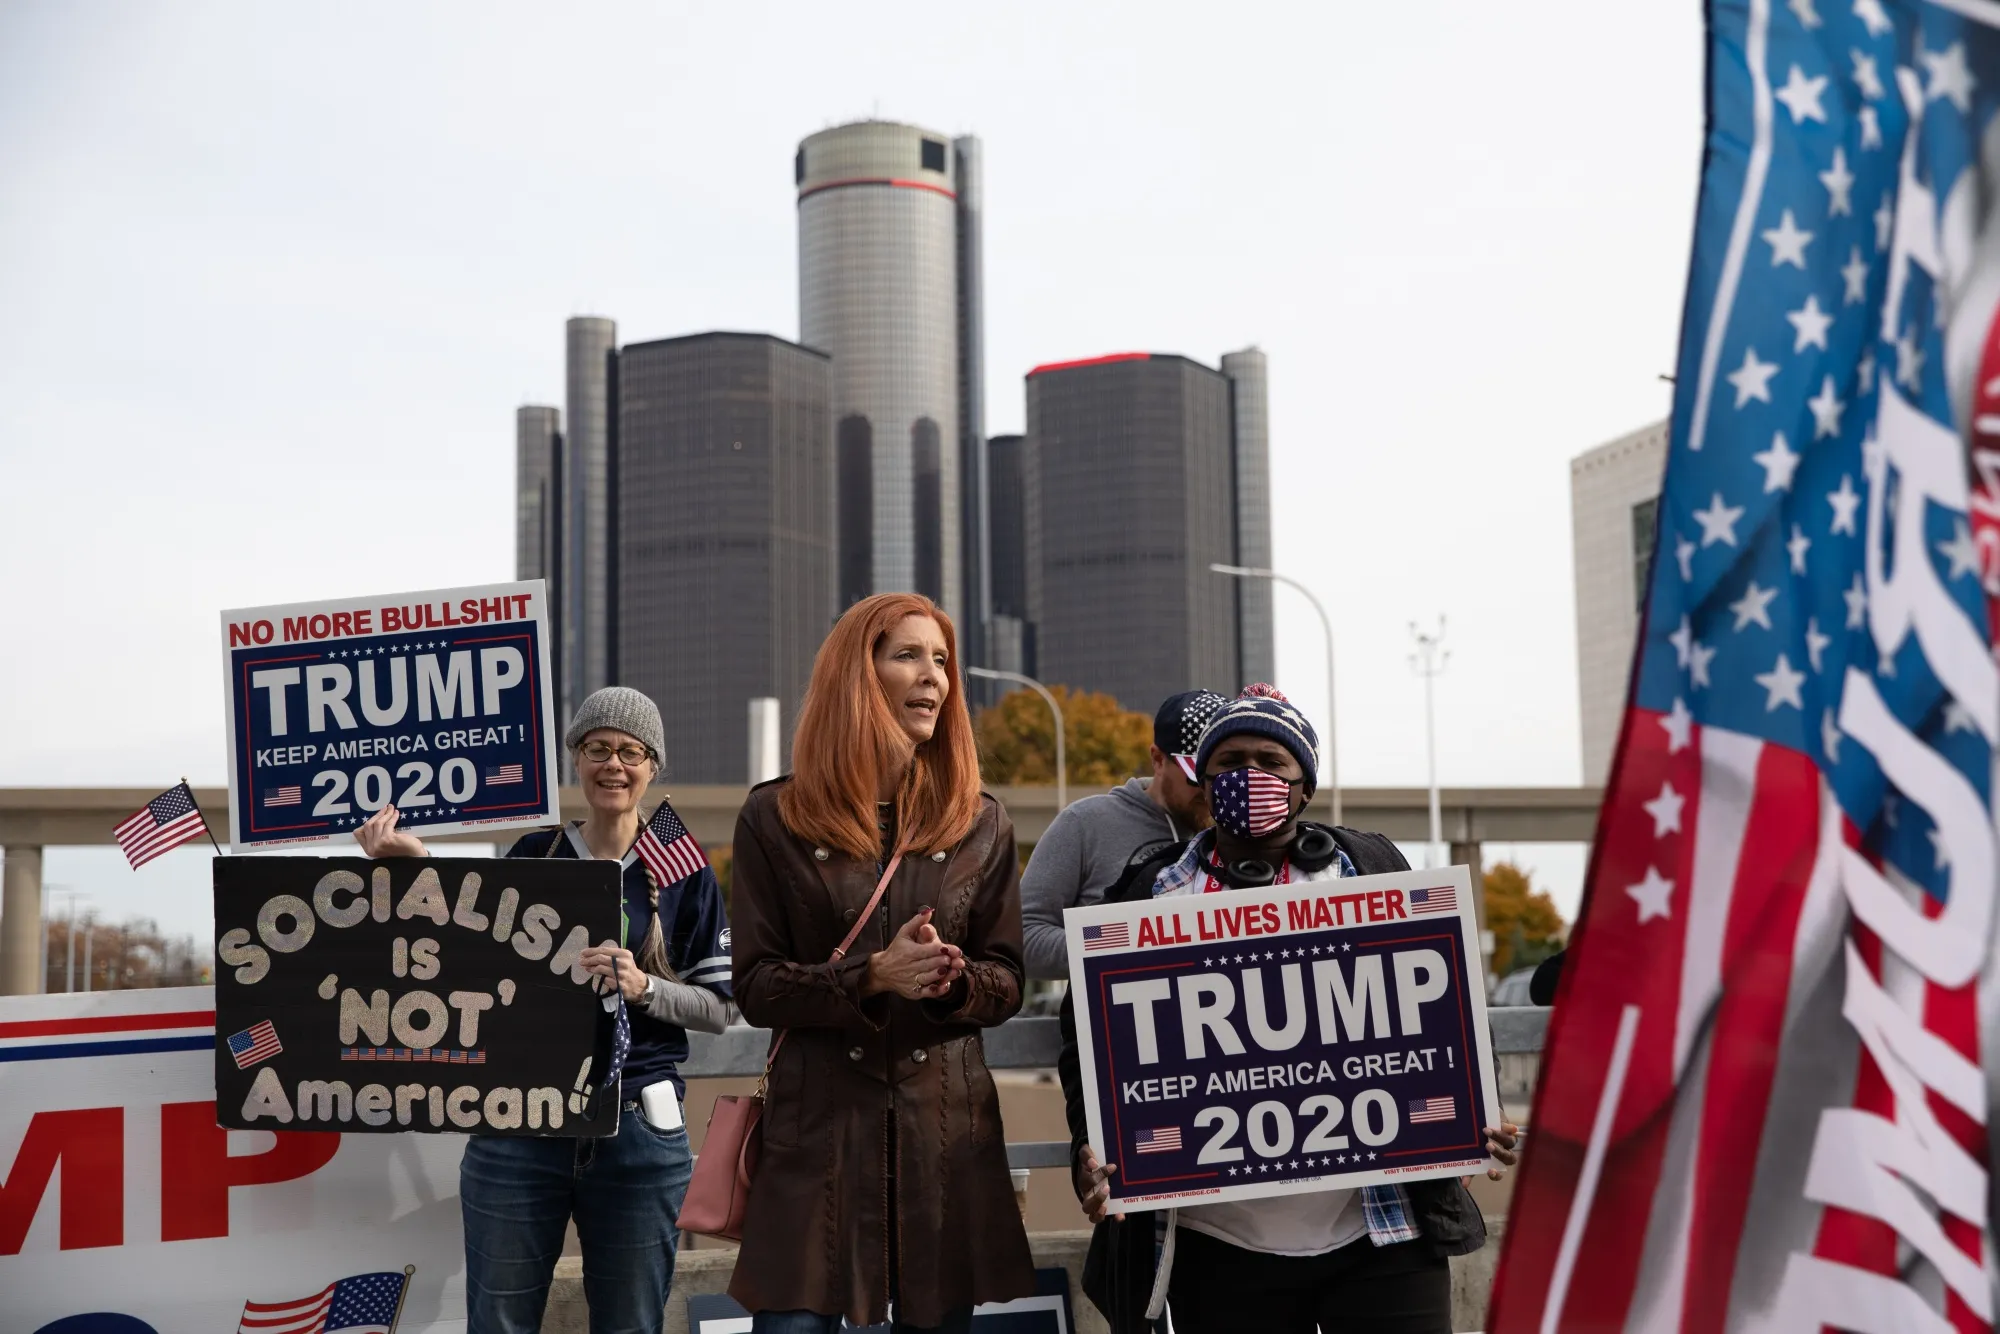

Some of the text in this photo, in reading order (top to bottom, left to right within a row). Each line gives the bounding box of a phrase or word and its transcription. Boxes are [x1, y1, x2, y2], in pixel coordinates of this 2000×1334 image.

[229, 594, 532, 647] NO MORE BULLSHIT
[252, 646, 525, 737] TRUMP
[256, 746, 317, 767] KEEP
[323, 734, 429, 761] AMERICA
[434, 726, 512, 750] GREAT
[311, 757, 478, 817] 2020
[265, 835, 330, 846] TRUMPUNITYBRIDGE.COM
[475, 814, 541, 825] TRUMPUNITYBRIDGE.COM
[218, 866, 619, 994] SOCIALISM
[1137, 889, 1407, 948] ALL LIVES MATTER
[392, 936, 441, 981] IS
[1111, 948, 1449, 1066] TRUMP
[241, 1055, 593, 1130] American!
[1122, 1075, 1198, 1105] KEEP
[1205, 1060, 1336, 1095] AMERICA
[1342, 1048, 1438, 1079] GREAT
[1193, 1088, 1400, 1166] 2020
[1140, 1188, 1221, 1202] TRUMPUNITYBRIDGE.COM
[1383, 1160, 1482, 1175] VISIT TRUMPUNITYBRIDGE.COM
